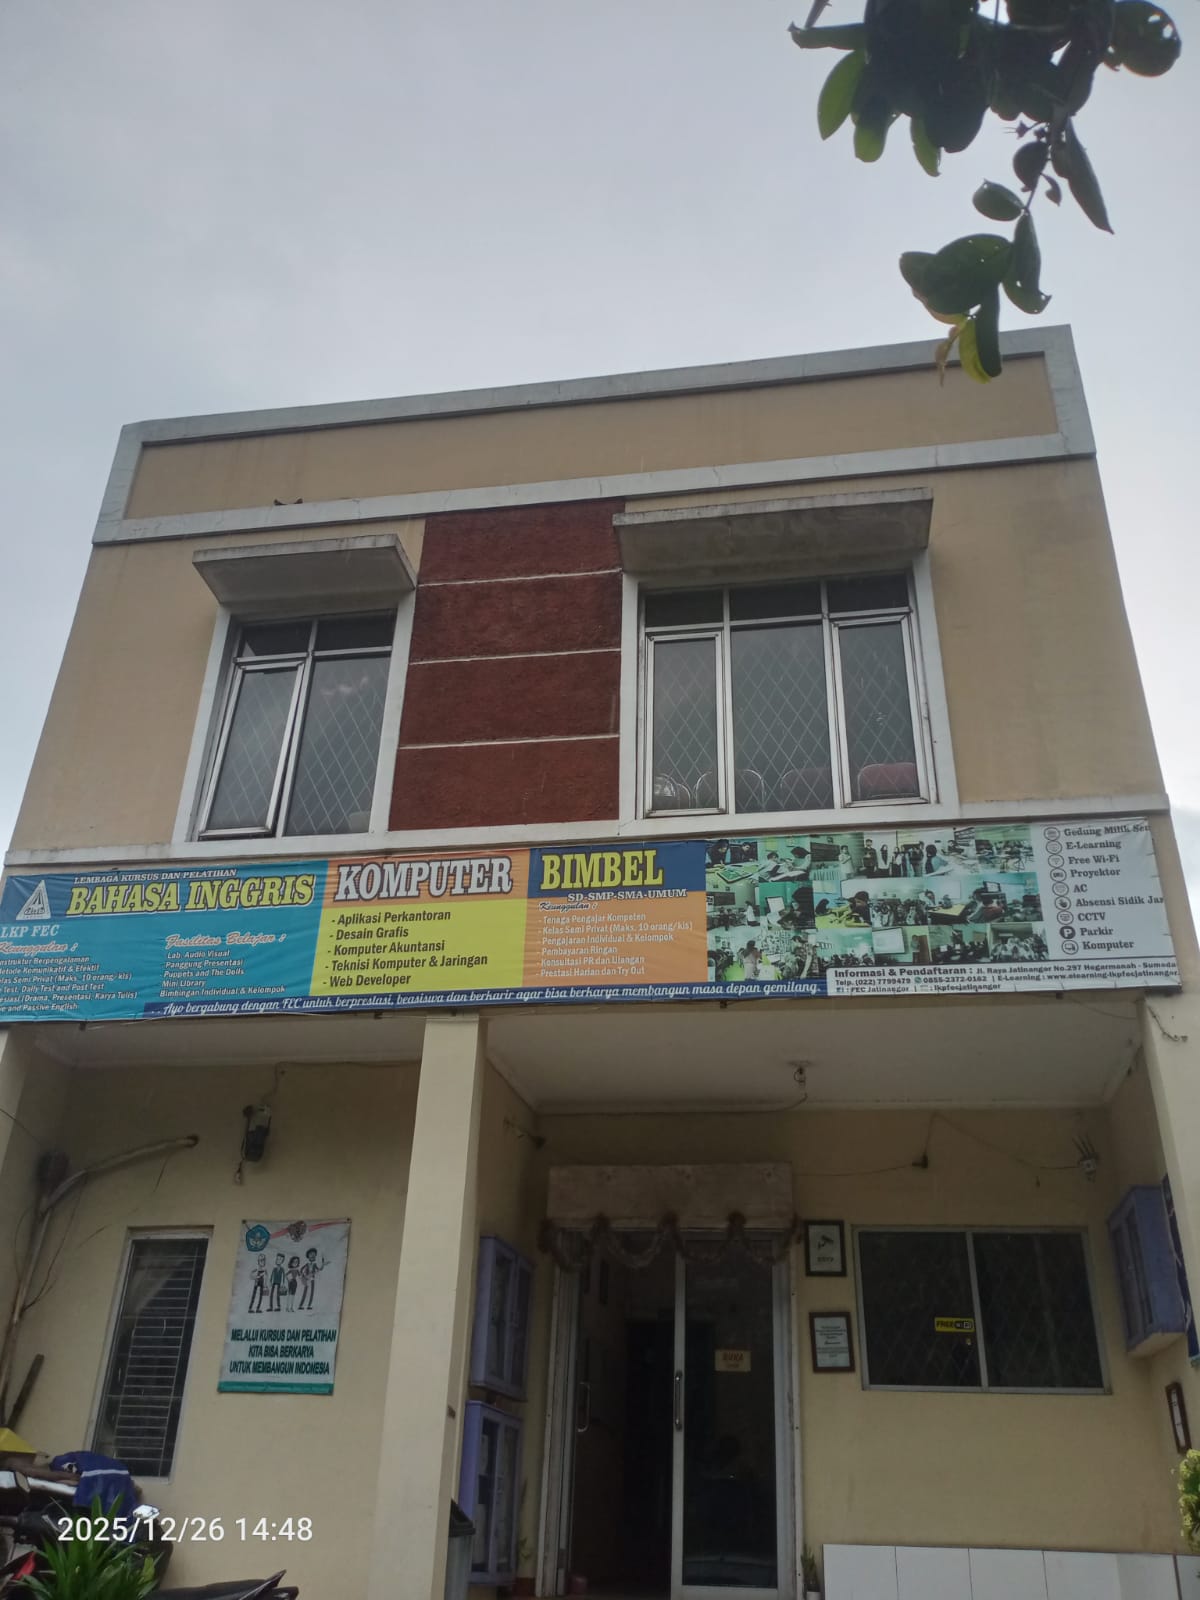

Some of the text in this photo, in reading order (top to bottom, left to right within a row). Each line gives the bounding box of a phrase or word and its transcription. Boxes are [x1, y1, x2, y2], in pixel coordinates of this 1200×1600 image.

[1064, 828, 1102, 837] Gedung
[1066, 840, 1122, 850] E-Learning
[1068, 855, 1120, 865] Free Wi-Fi
[540, 850, 664, 890] BIMBEL
[1070, 868, 1121, 878] Proyektor
[74, 869, 237, 884] LEMBAGA KURSUS DAN PELATIHAN
[334, 856, 513, 902] KOMPUTER
[1073, 884, 1088, 893] AC
[65, 874, 316, 916] BAHASA INGGRIS
[567, 888, 688, 902] SD-SMP-SMA-UMUM
[1076, 897, 1116, 907] Absensi
[1118, 896, 1145, 904] Sidik
[337, 910, 451, 926] Aplikasi Perkantoran
[608, 913, 646, 922] Kompeten
[1078, 912, 1106, 921] CCTV
[0, 925, 59, 938] LKP FEC
[336, 926, 409, 940] Desain Grafis
[543, 926, 564, 934] Kelas
[565, 925, 584, 934] Semi
[586, 924, 608, 933] Privat
[639, 922, 648, 930] 10
[1080, 927, 1114, 936] Parkir
[226, 931, 275, 947] Belajar
[334, 940, 445, 957] Komputer Akuntansi
[542, 946, 617, 956] Pembayaran Ringan
[1082, 940, 1134, 952] Komputer
[33, 957, 90, 966] Berpengalaman
[165, 959, 243, 970] Panggung Presentasi
[332, 954, 488, 971] Teknisi Komputer & Jaringan
[541, 957, 582, 967] Konsultasi
[612, 956, 645, 965] Ulangan
[23, 966, 67, 975] Komunikatif
[76, 964, 99, 972] Efektif
[163, 970, 194, 979] Puppets
[541, 969, 573, 977] Prestasi
[601, 967, 616, 975] dan
[618, 967, 629, 976] Try
[630, 967, 645, 975] Out
[834, 969, 886, 978] Informasi
[888, 968, 897, 976] &
[899, 967, 967, 976] Pendaftaran
[180, 980, 206, 988] Library
[329, 973, 412, 988] Web Developer
[22, 985, 38, 993] Daily
[160, 989, 199, 998] Bimbingan
[201, 987, 238, 996] Individual
[248, 985, 285, 996] Kelompok
[95, 992, 115, 1000] Karya
[163, 1002, 184, 1016] Ayo
[185, 1001, 240, 1015] bergabung
[241, 1000, 280, 1013] dengan
[282, 998, 303, 1009] FEC
[303, 997, 333, 1009] untuk
[397, 992, 445, 1006] beasiswa
[446, 992, 468, 1003] dan
[470, 990, 515, 1002] berkarir
[515, 989, 544, 1001] agar
[545, 986, 568, 999] bisa
[569, 986, 621, 1001] berkarya
[622, 984, 690, 999] membangun
[692, 984, 724, 995] masa
[726, 981, 761, 997] depan
[763, 980, 821, 996] gemilang.
[51, 1003, 78, 1011] English
[231, 1328, 337, 1342] MELALUI KURSUS DAN PELATIHAN
[248, 1345, 314, 1358] KITA BISA BERKARYA
[229, 1361, 330, 1375] UNTUK MEMBANGUN INDONESIA
